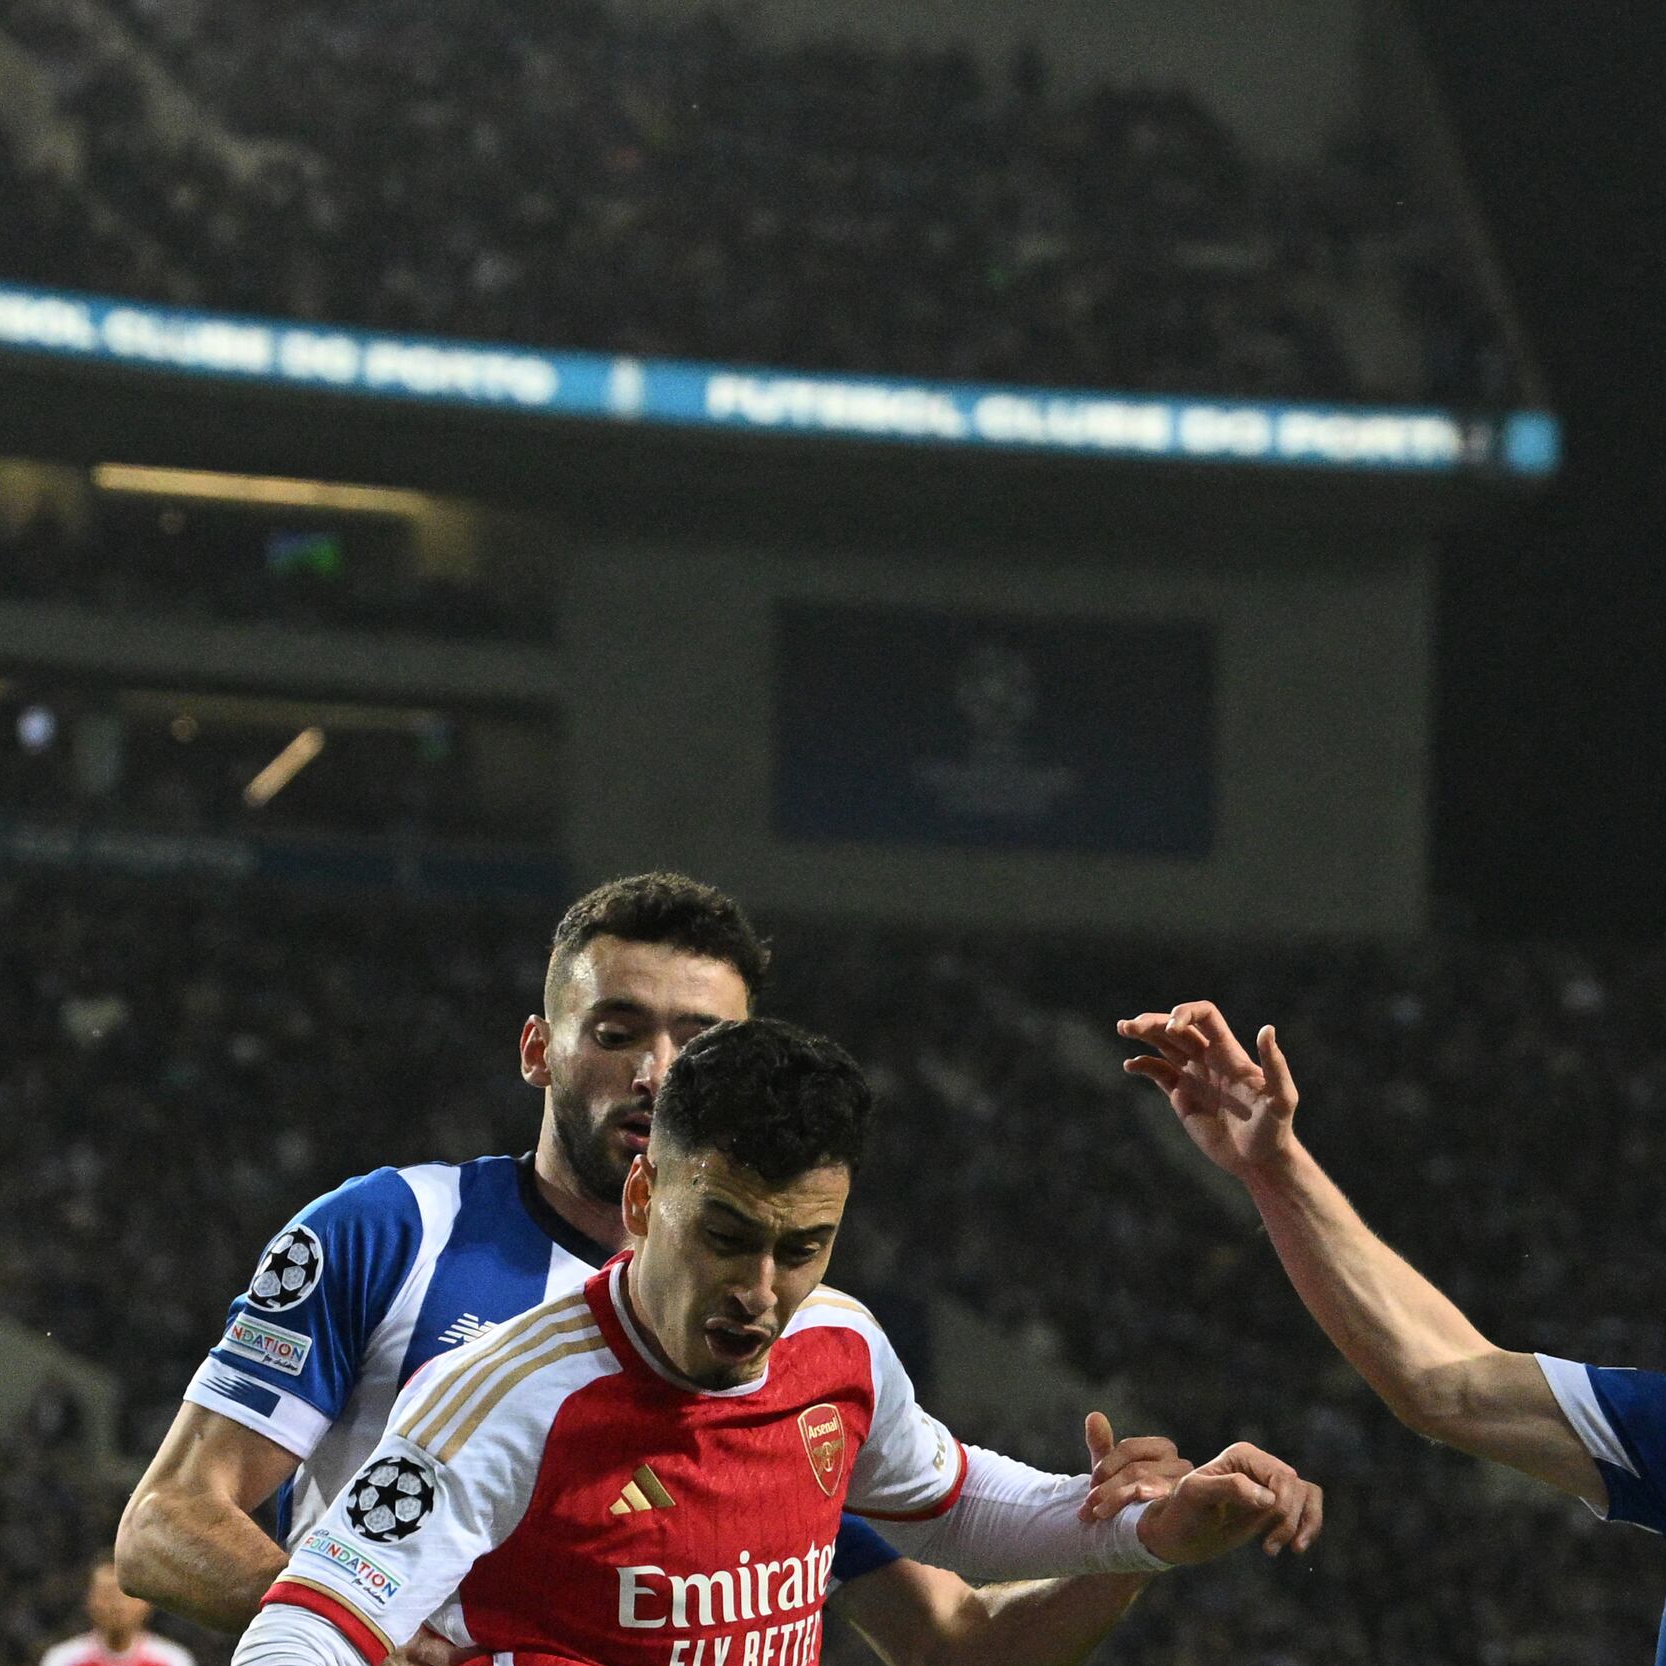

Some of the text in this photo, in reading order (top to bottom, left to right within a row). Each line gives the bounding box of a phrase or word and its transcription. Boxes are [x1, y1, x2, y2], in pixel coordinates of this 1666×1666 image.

[232, 1325, 305, 1362] NDATION
[807, 1416, 839, 1440] Arsenal
[303, 1535, 399, 1599] FOUNDATION
[615, 1538, 837, 1630] Emirate
